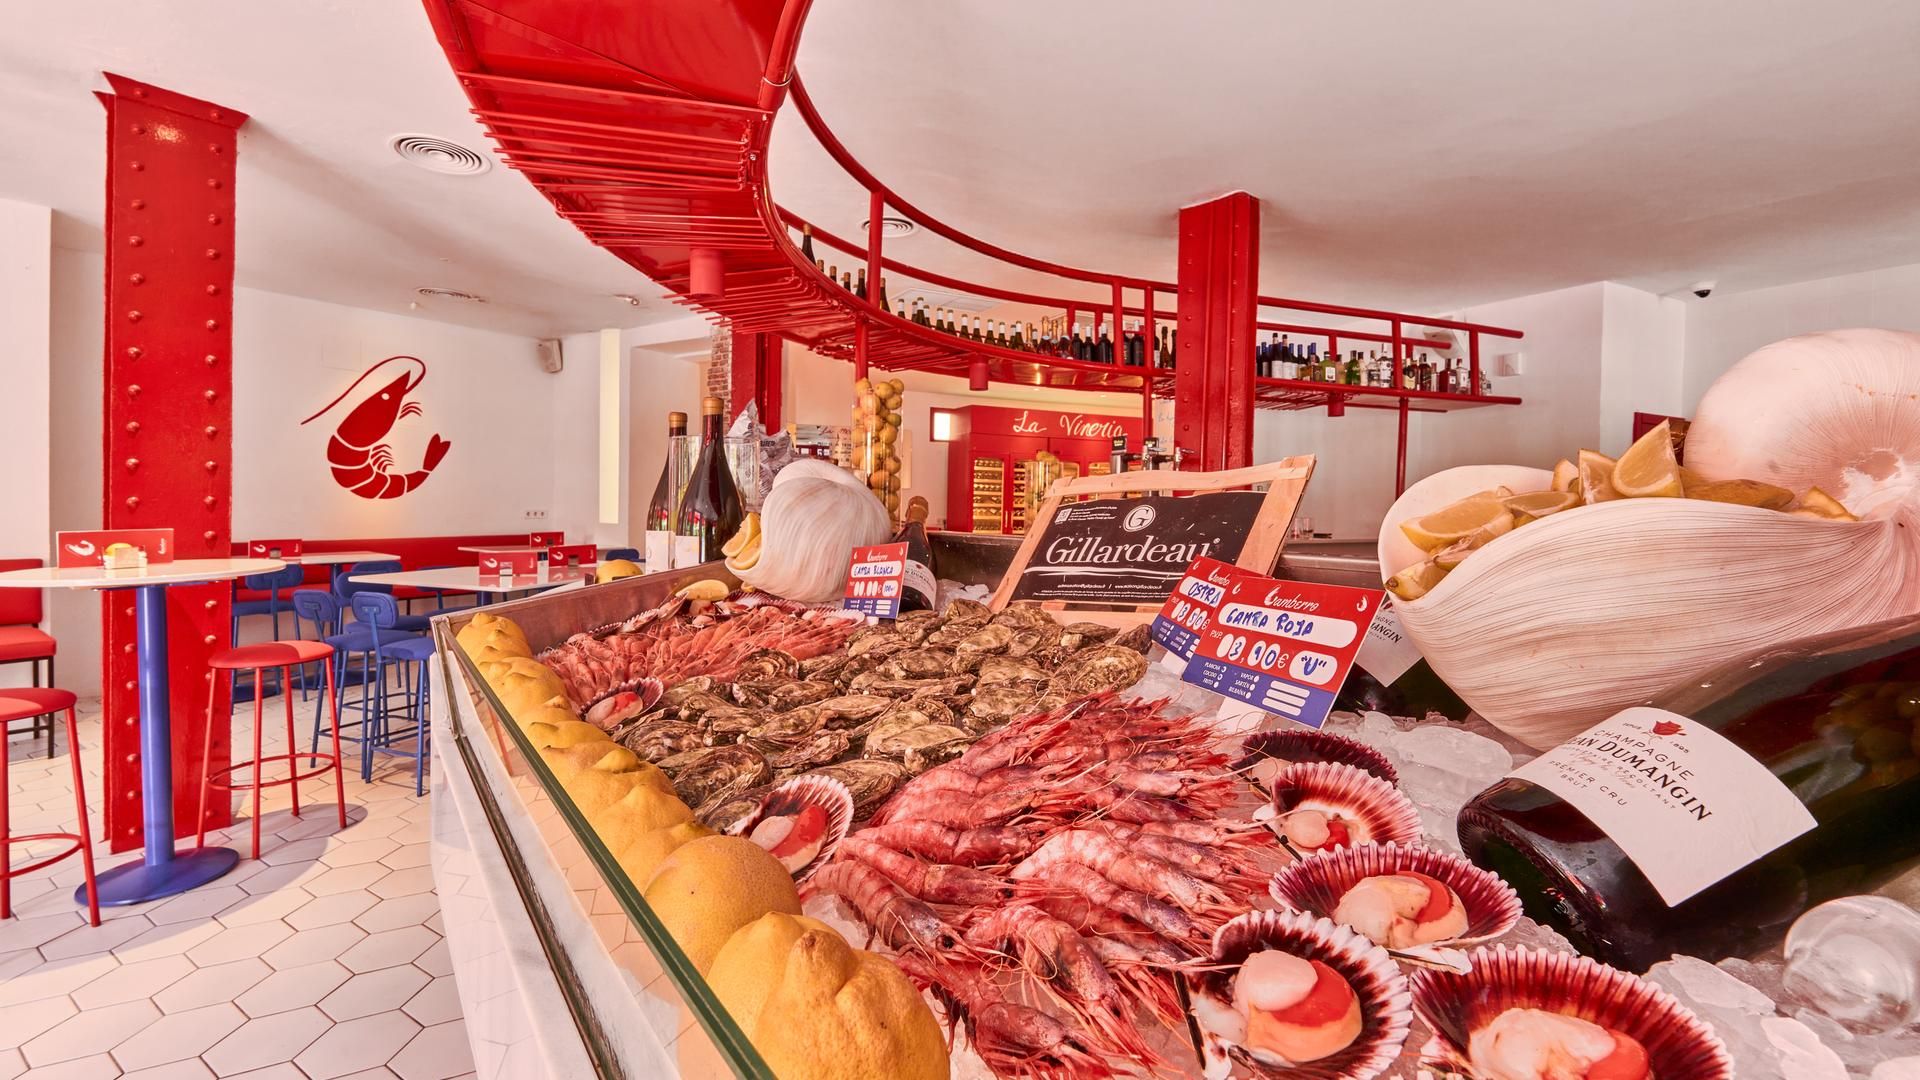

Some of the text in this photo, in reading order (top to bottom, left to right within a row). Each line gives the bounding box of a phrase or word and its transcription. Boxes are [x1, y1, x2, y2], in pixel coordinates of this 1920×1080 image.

[1013, 410, 1047, 433] La
[1046, 535, 1211, 565] Gillardeau
[1276, 612, 1314, 636] ROJA
[1594, 729, 1695, 781] CHAMPAGNE
[1549, 760, 1596, 784] PREMIER
[1599, 785, 1628, 806] CRU
[1560, 773, 1588, 790] BRUT
[1597, 741, 1712, 821] DUMANGIN
